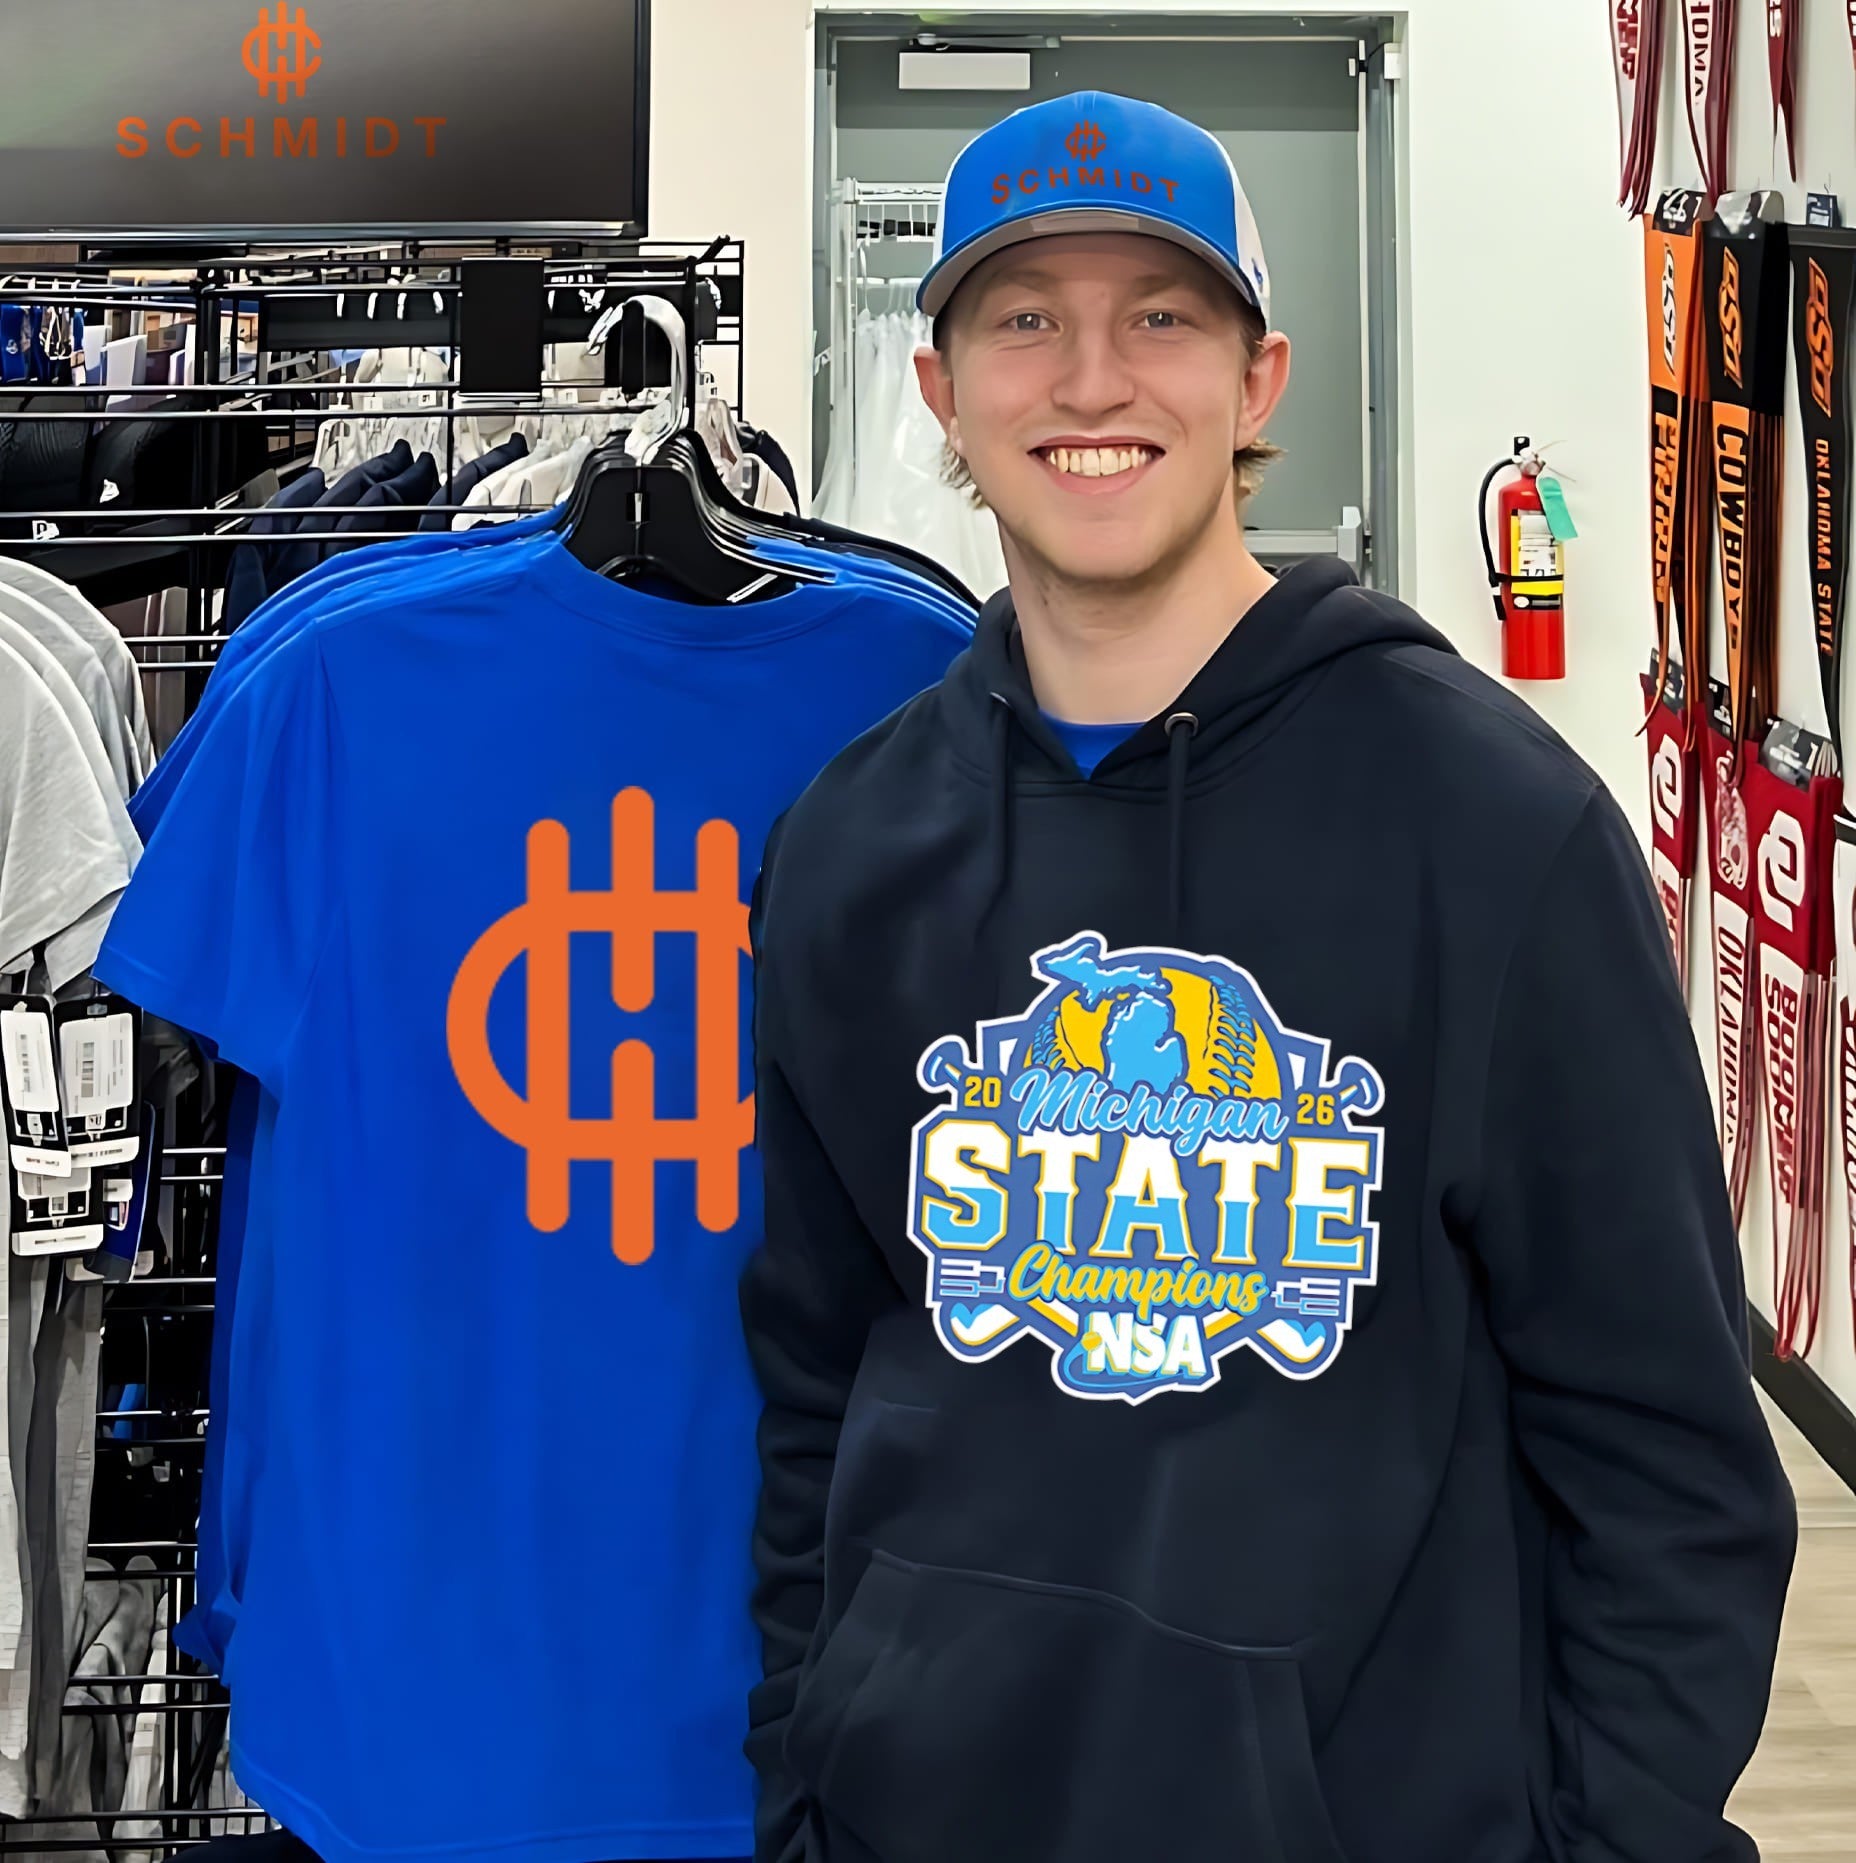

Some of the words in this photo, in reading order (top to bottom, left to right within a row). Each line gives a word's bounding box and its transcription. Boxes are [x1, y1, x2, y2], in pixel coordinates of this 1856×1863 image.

[115, 116, 447, 158] SCHMIDT
[991, 167, 1179, 205] SCHMIDT
[964, 1077, 1001, 1108] 20
[1010, 1068, 1288, 1157] Michigan
[1296, 1093, 1334, 1125] 26
[921, 1119, 1370, 1271] STATE
[1008, 1242, 1270, 1323] Champions
[1084, 1311, 1206, 1377] NSA
